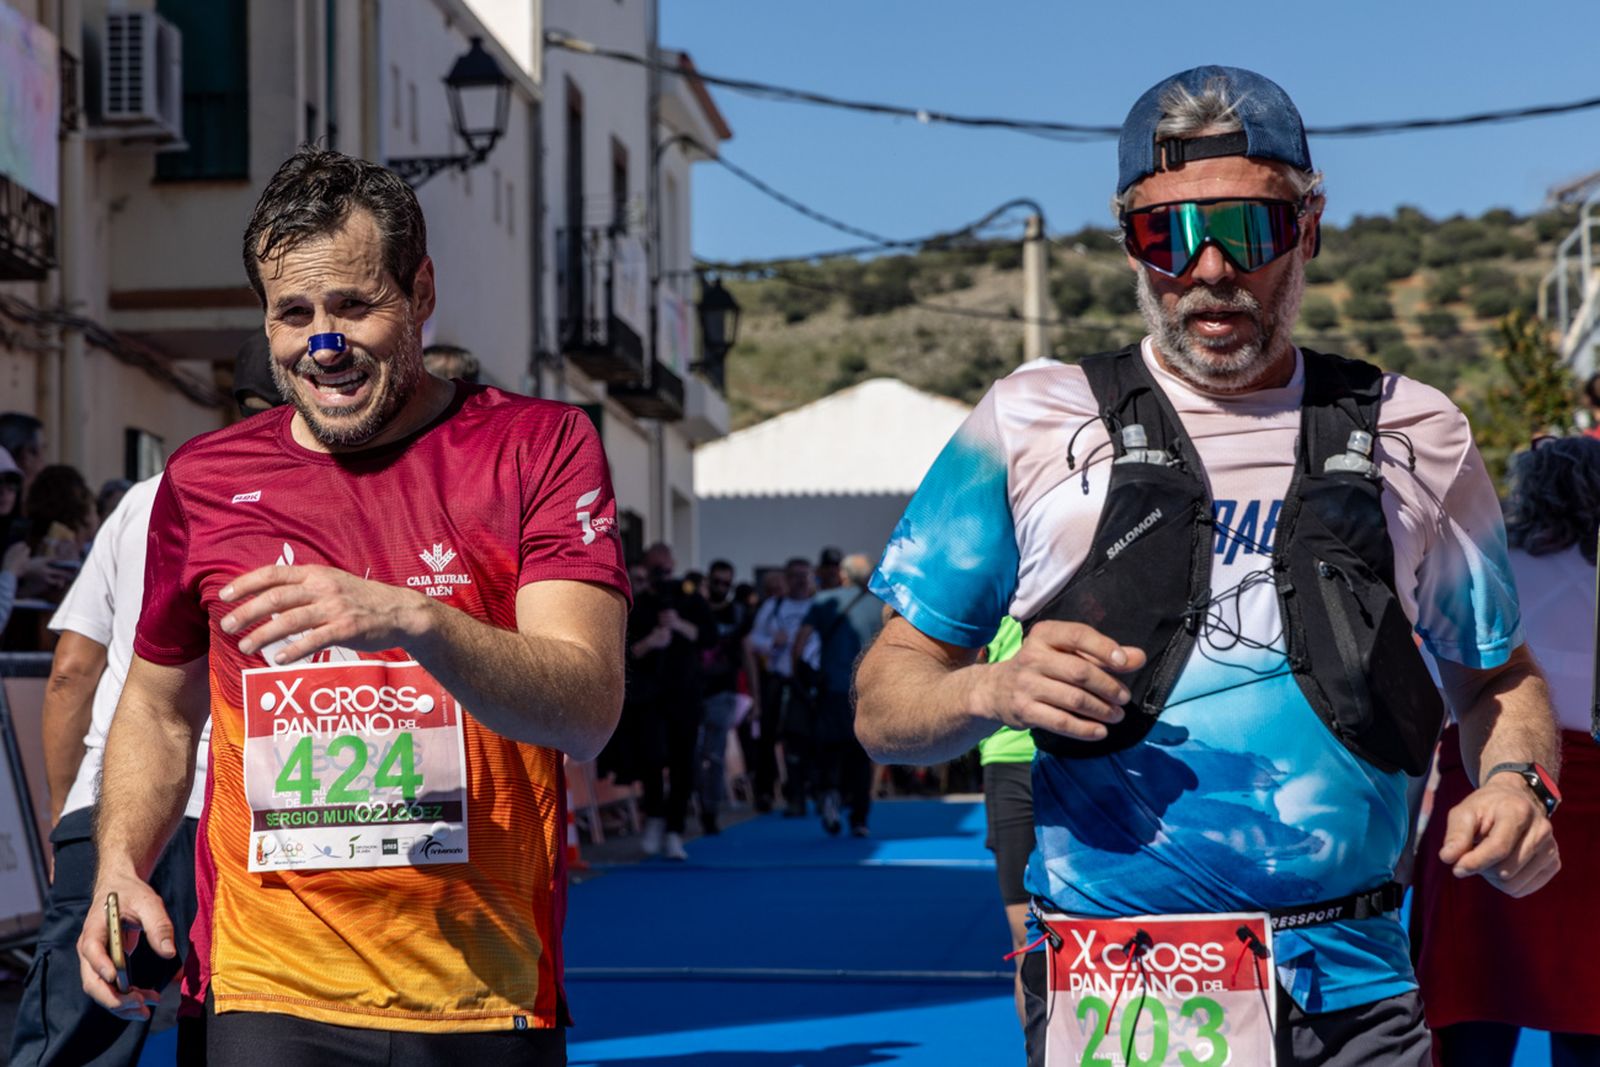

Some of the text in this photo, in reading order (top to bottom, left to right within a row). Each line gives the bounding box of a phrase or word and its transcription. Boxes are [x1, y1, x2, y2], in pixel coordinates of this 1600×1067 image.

[1106, 508, 1162, 560] SALOMON
[407, 574, 472, 586] CAJA RURAL
[426, 585, 453, 597] JAÉN
[275, 678, 304, 716] X
[310, 685, 418, 714] CROSS
[273, 713, 421, 742] PANTANO DEL
[275, 732, 424, 805] 424
[265, 811, 320, 827] SERGIO
[1271, 906, 1344, 930] RESSPORT
[1070, 929, 1097, 970] X
[1101, 942, 1227, 973] CROSS
[1069, 972, 1228, 1000] PANTANO DEL
[1076, 995, 1229, 1067] 203
